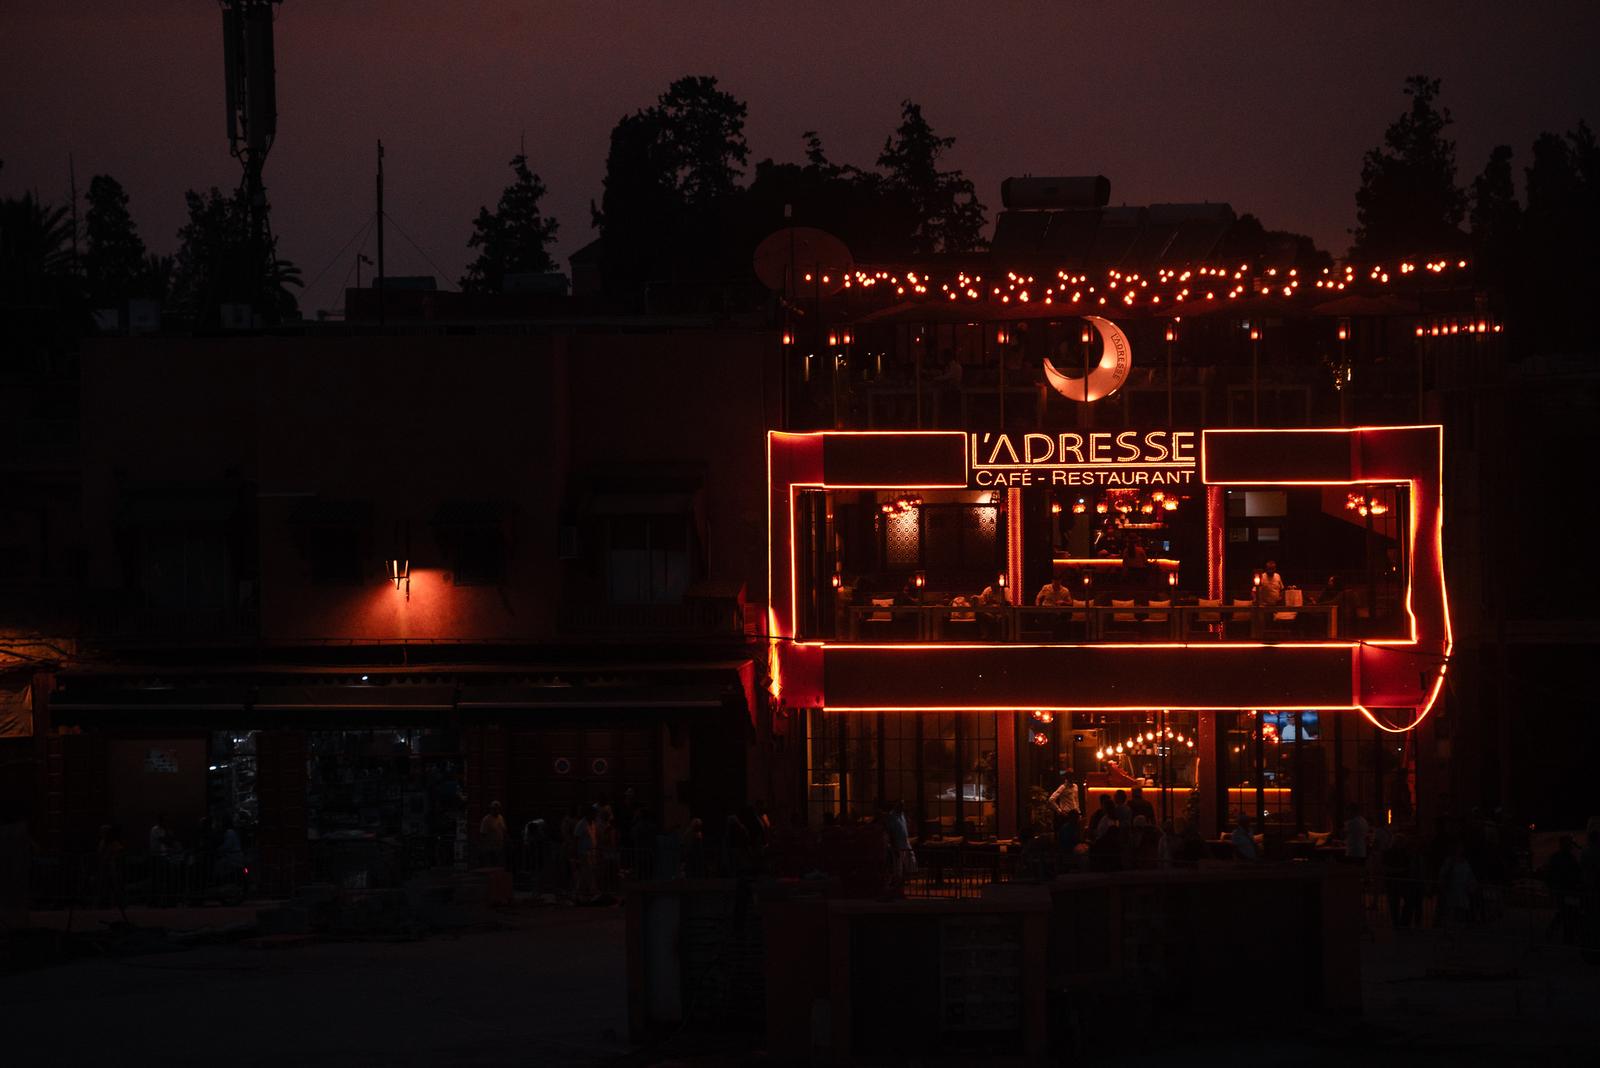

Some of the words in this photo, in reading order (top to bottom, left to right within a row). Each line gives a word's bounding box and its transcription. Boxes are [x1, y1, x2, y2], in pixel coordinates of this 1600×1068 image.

[1111, 333, 1125, 380] L'ADRESSE
[972, 431, 1195, 468] L'ADRESSE
[976, 469, 1032, 486] CAFÉ
[1052, 470, 1195, 485] RESTAURANT
